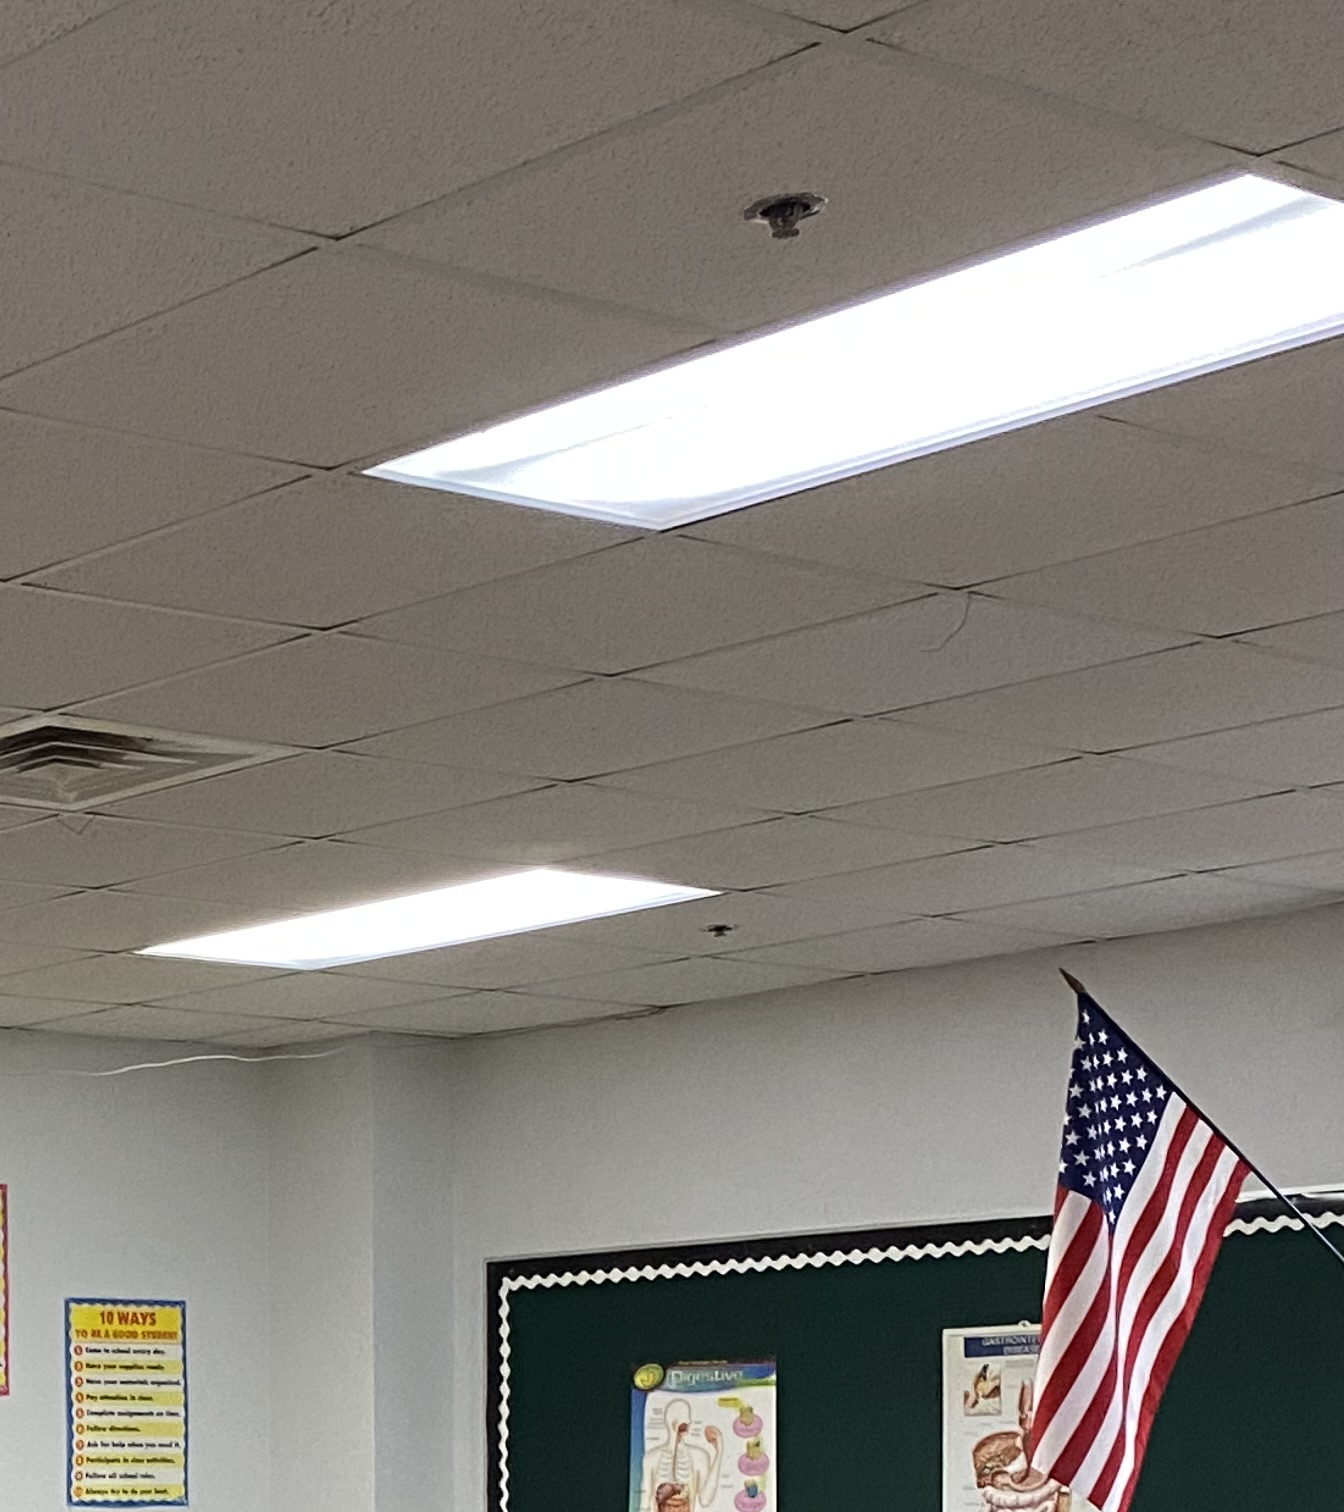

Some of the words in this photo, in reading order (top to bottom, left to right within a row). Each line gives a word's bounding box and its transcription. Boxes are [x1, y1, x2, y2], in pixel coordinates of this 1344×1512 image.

[100, 1311, 114, 1325] 10
[117, 1311, 157, 1326] WAYS
[75, 1329, 88, 1339] TO
[104, 1330, 110, 1339] A
[112, 1330, 138, 1340] GOOD
[142, 1331, 178, 1340] STUDENT
